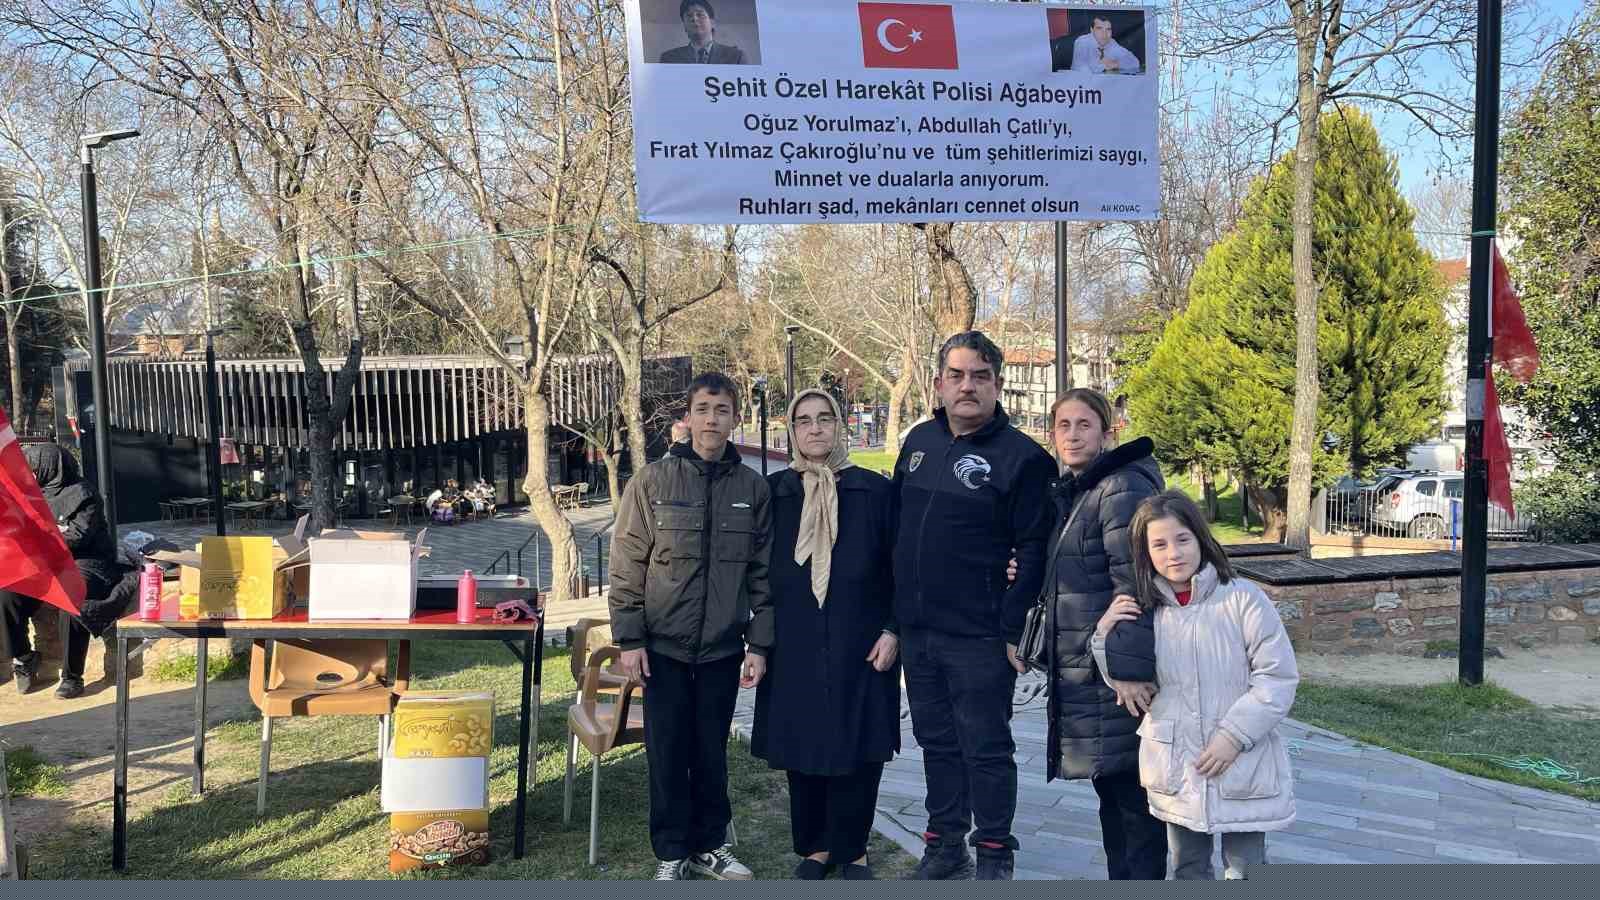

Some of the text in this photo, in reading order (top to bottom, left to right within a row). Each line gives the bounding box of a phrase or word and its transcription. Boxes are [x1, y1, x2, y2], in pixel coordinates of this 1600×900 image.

[704, 72, 1102, 109] Şehit Özel Harekât Polisi Ağabeyim
[743, 113, 1072, 140] Oğuz Yorulmaz'ı, Abdullah Çatlı'yı,
[650, 140, 1148, 167] Fırat Yılmaz Çakıroğlu'nu ve tüm şehitlerimizi saygı,
[774, 169, 1049, 192] Minnet ve dualarla anıyorum.
[739, 195, 1079, 220] Ruhları şad, mekânları cennet olsun
